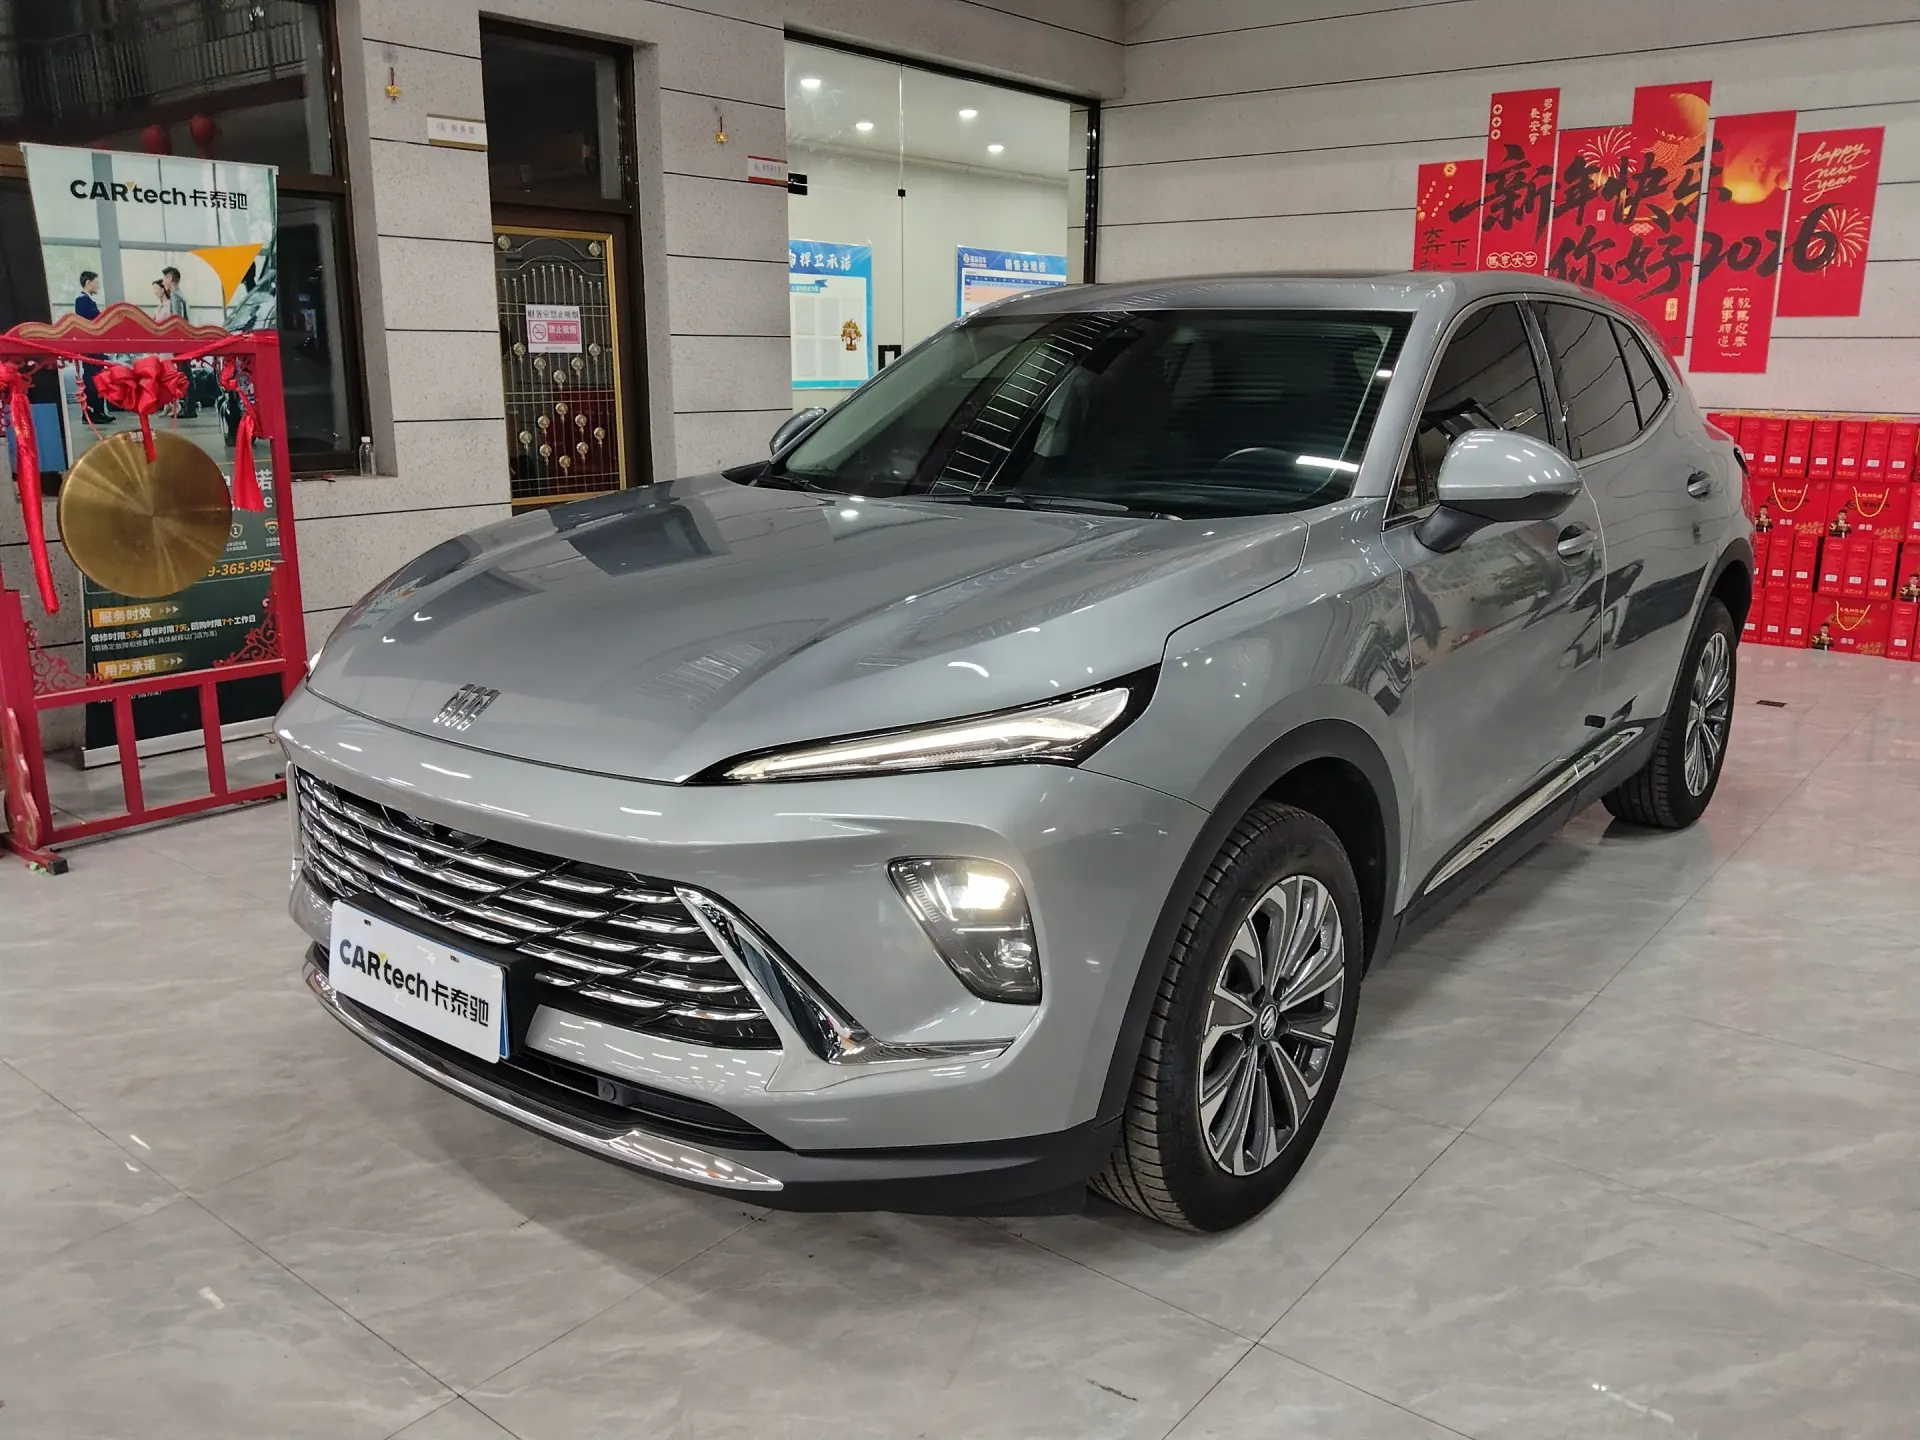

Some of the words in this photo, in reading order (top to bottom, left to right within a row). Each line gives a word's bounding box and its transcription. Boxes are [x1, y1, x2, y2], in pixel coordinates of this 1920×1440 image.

[1799, 141, 1871, 167] happy
[1804, 161, 1869, 181] new
[189, 188, 248, 211] 卡泰驰
[1448, 138, 1733, 245] 新年快乐
[1802, 175, 1858, 204] year
[99, 606, 152, 624] 服务时效
[104, 658, 157, 677] 用户承诺
[431, 980, 490, 1028] 卡泰驰
